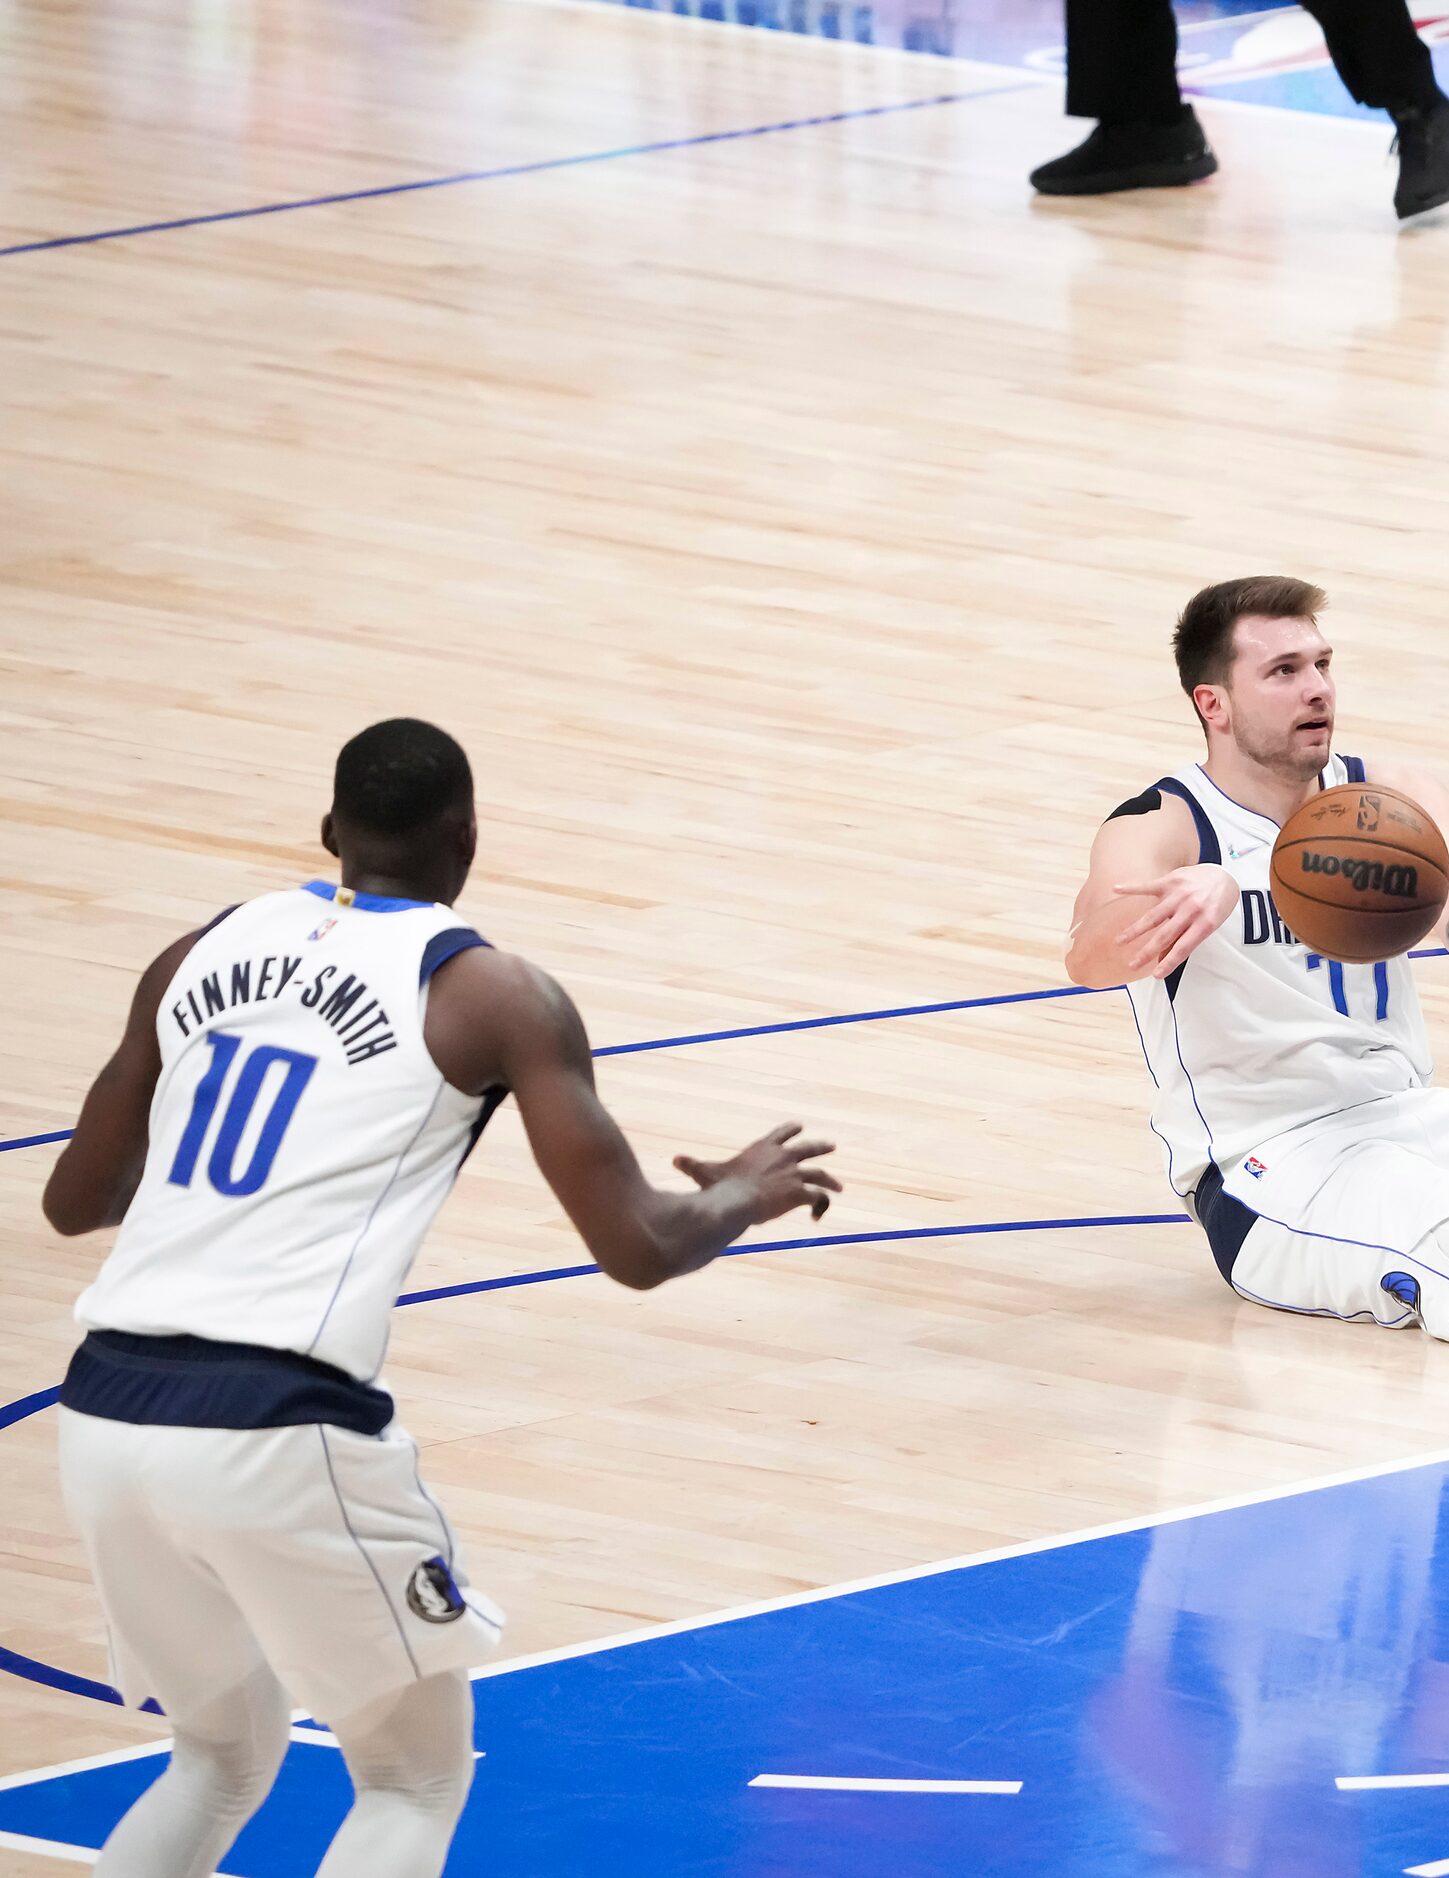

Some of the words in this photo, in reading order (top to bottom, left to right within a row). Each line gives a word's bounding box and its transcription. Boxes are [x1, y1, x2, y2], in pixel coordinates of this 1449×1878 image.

[1300, 851, 1418, 897] Wilson
[171, 956, 397, 1066] FINNEY-SMITH
[167, 1029, 319, 1197] 10
